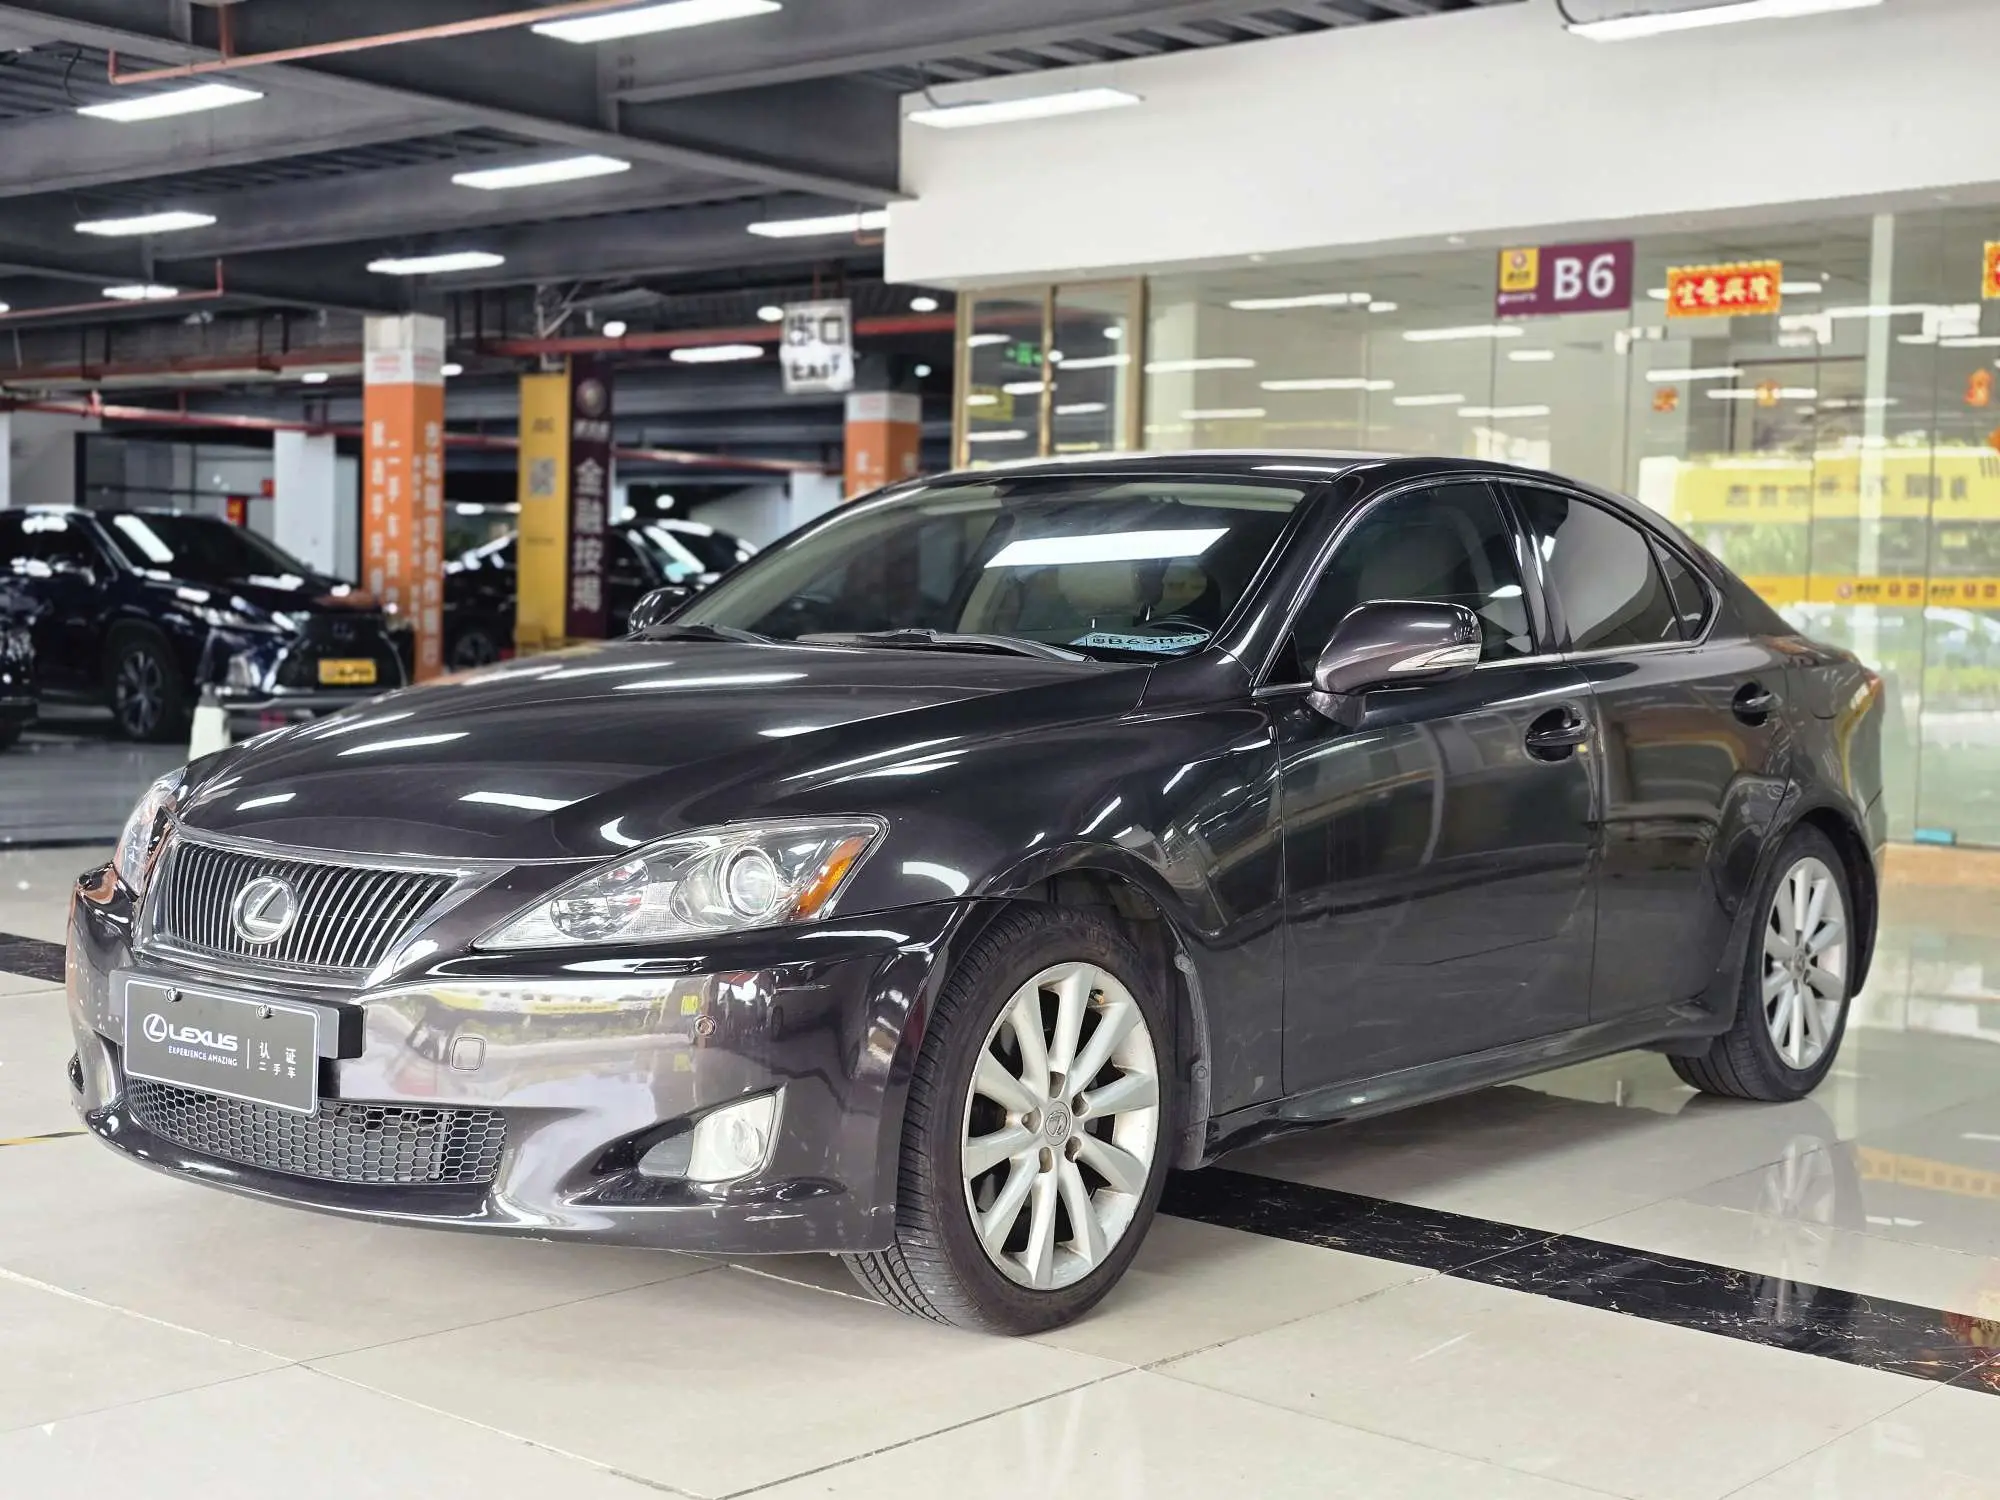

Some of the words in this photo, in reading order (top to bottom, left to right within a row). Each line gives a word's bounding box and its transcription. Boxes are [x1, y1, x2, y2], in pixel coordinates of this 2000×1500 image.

[1553, 253, 1615, 300] B6
[573, 456, 605, 613] 金融按揭
[168, 1023, 239, 1052] LEXUS
[168, 1045, 207, 1062] EXPERIENCE
[207, 1053, 239, 1067] AMAZING
[258, 1060, 298, 1079] 二手车
